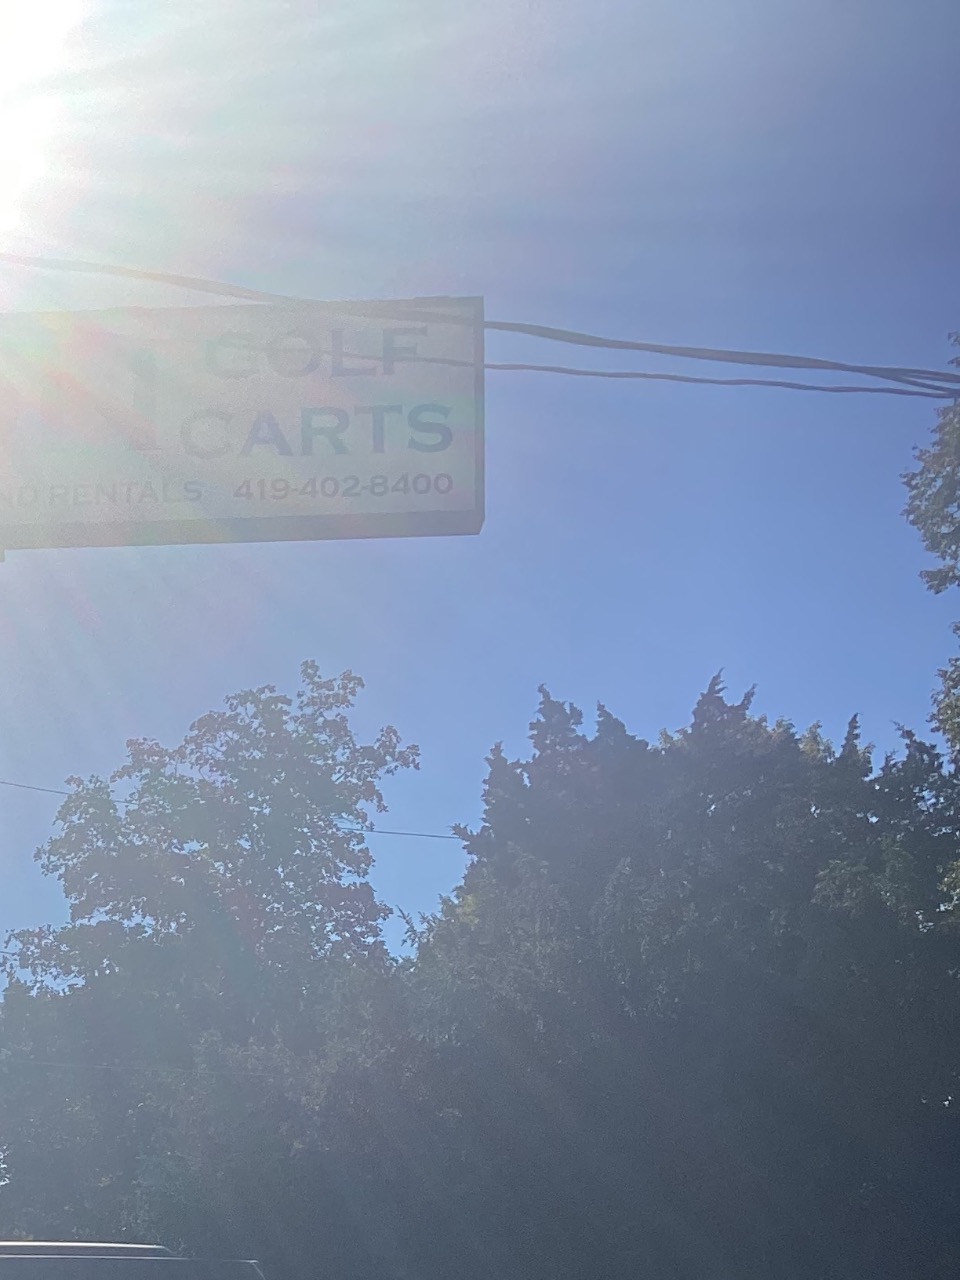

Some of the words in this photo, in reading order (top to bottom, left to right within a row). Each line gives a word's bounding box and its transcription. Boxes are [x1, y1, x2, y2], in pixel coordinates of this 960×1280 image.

[206, 326, 429, 380] GOLF
[179, 402, 455, 460] CARTS
[49, 479, 202, 508] RENTALS
[233, 473, 454, 502] 419-402-8400
